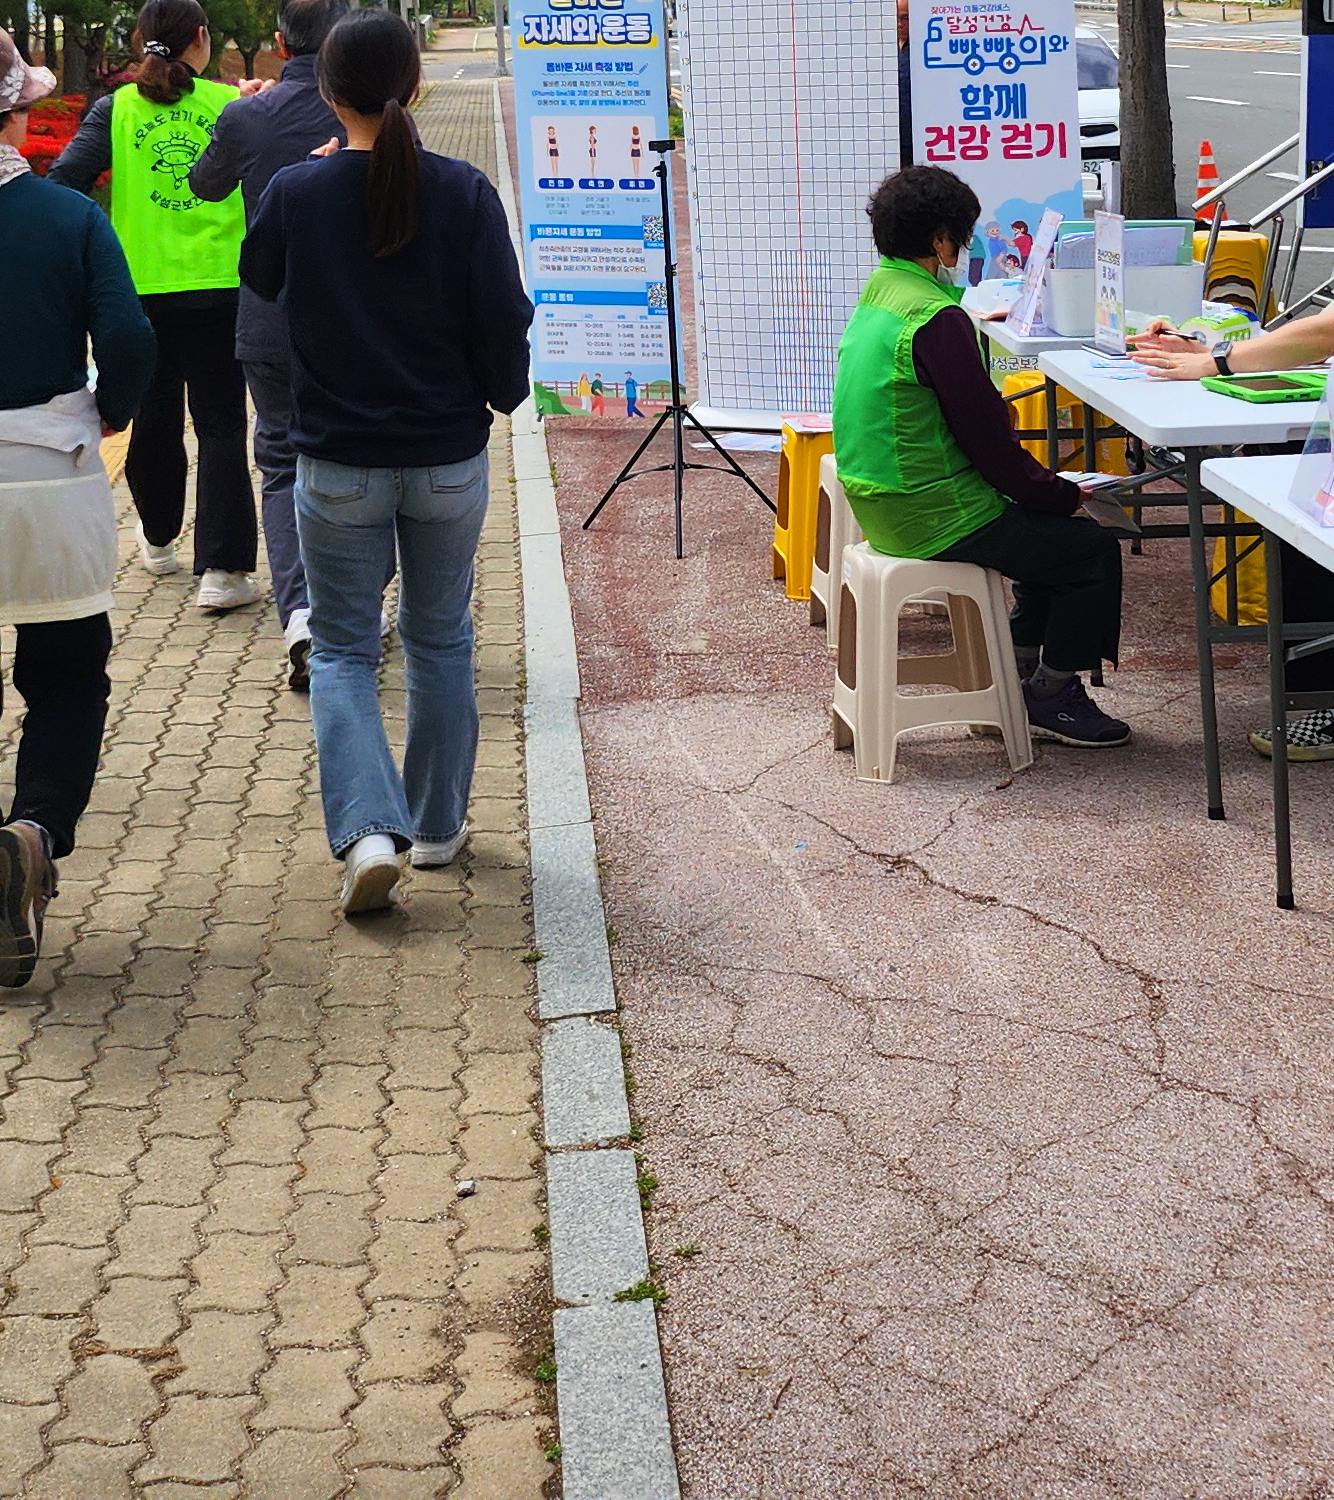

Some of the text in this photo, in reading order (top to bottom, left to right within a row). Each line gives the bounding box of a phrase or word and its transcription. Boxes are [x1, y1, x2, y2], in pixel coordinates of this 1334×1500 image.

[678, 4, 687, 12] 15
[931, 4, 1011, 14] 찾아가는 이동건강버스
[524, 13, 652, 44] 자세와 운동
[946, 14, 1012, 35] 달성건강
[681, 58, 690, 66] 13
[948, 34, 1069, 76] 빵빵이와
[546, 62, 634, 72] 올바른 자세 측정 방법
[683, 85, 690, 93] 12
[960, 83, 1027, 120] 함께
[684, 111, 692, 119] 11
[136, 113, 167, 142] 오늘도
[169, 110, 193, 122] 걷기
[925, 121, 1067, 161] 건강 걷기
